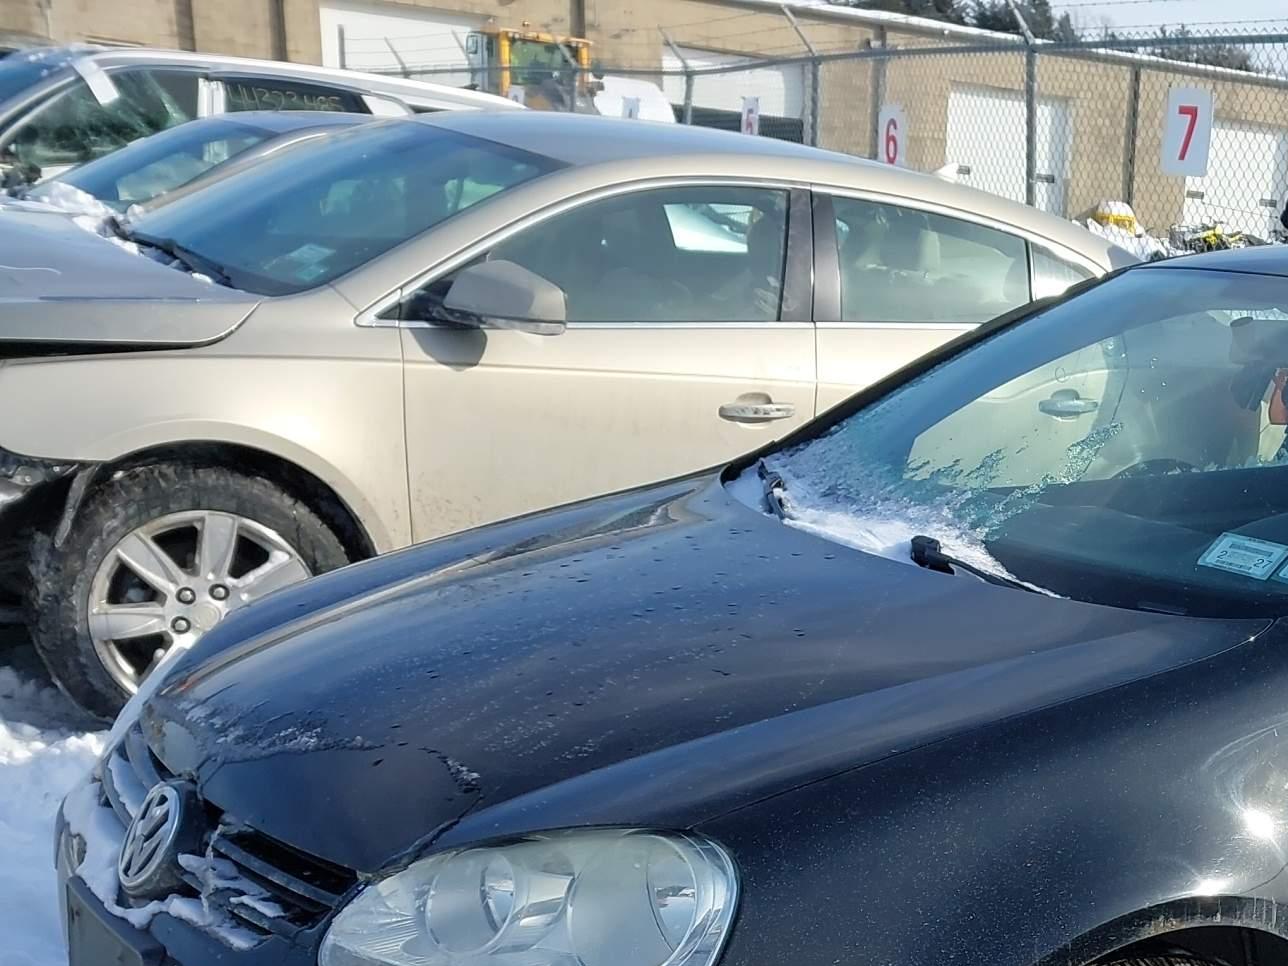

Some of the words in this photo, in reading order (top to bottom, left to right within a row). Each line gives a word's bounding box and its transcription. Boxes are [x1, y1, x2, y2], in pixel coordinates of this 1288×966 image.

[885, 117, 898, 164] 6
[1178, 106, 1198, 160] 7
[1253, 558, 1273, 569] 27
